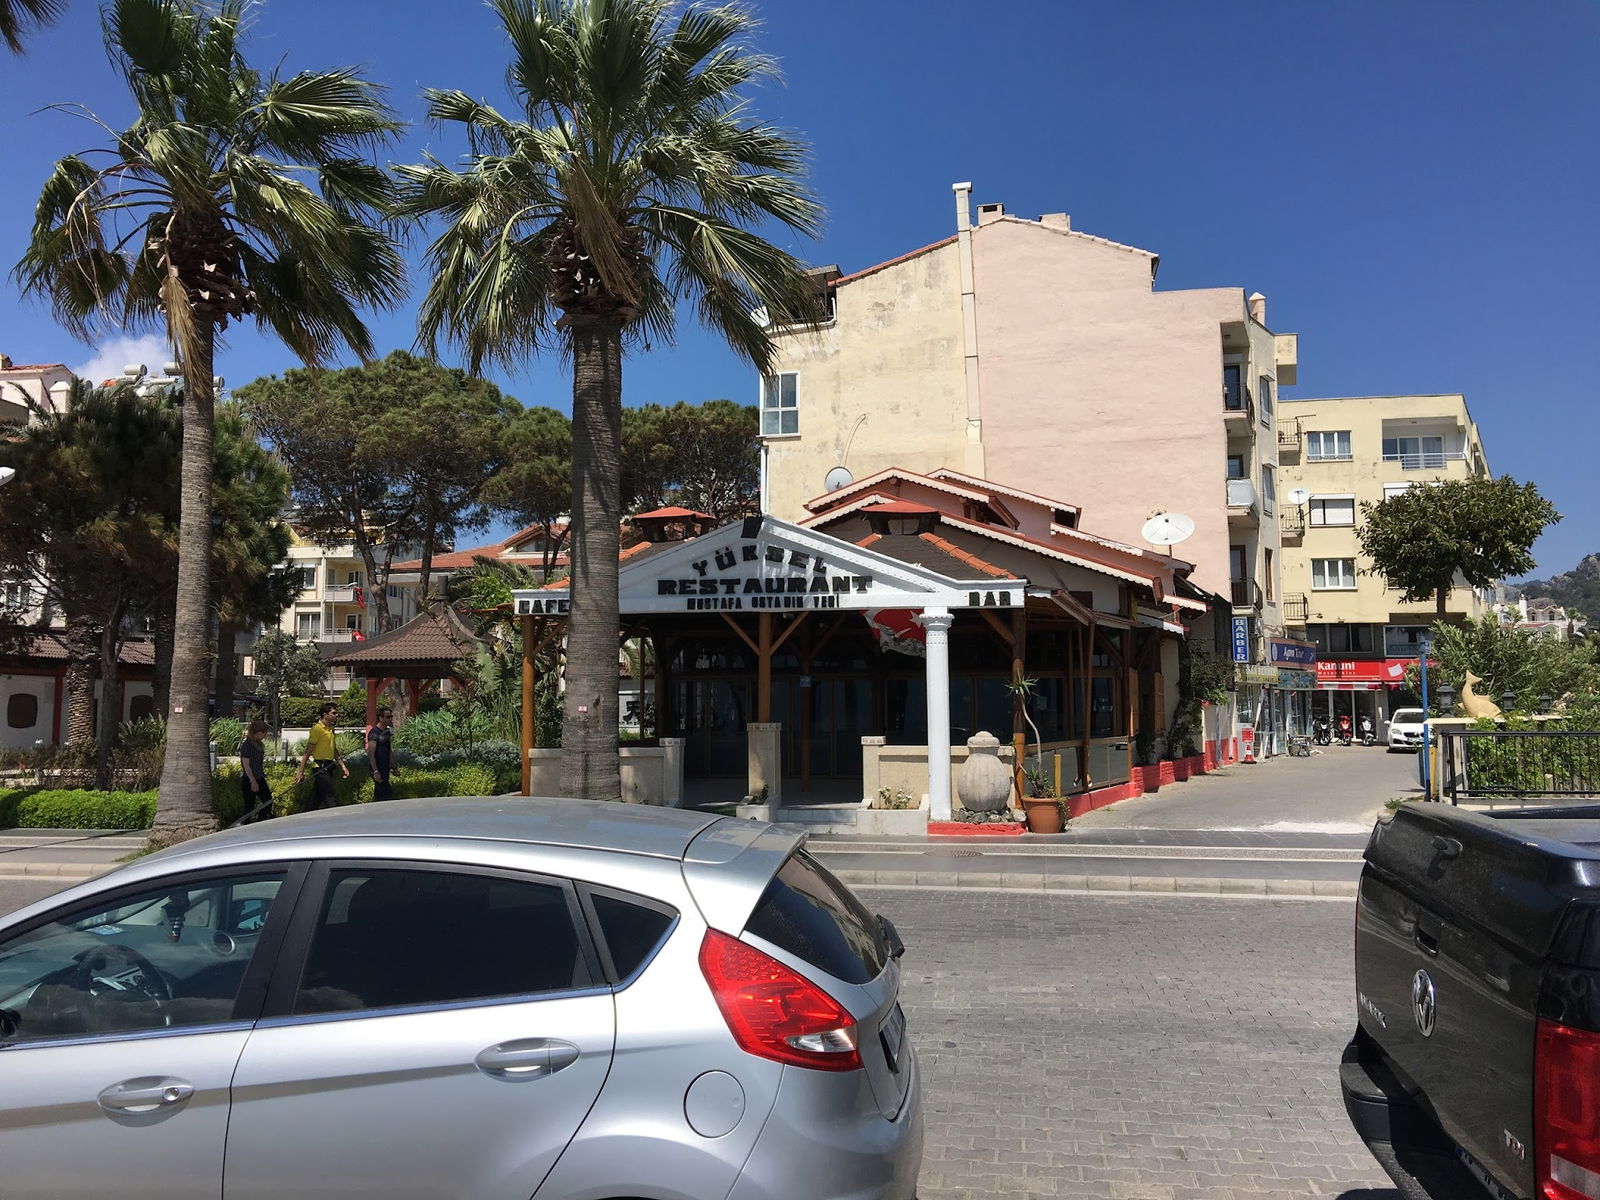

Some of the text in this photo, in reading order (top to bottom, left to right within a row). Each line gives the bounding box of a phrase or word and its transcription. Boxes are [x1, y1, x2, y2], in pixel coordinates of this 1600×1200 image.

[692, 546, 827, 576] YÜKSEL
[657, 576, 873, 595] RESTAURANT
[518, 599, 571, 613] CAFE
[687, 598, 742, 610] MUSTAFA
[969, 591, 1011, 607] BAR
[1235, 619, 1246, 660] BARBER
[1317, 661, 1355, 670] Kanuni
